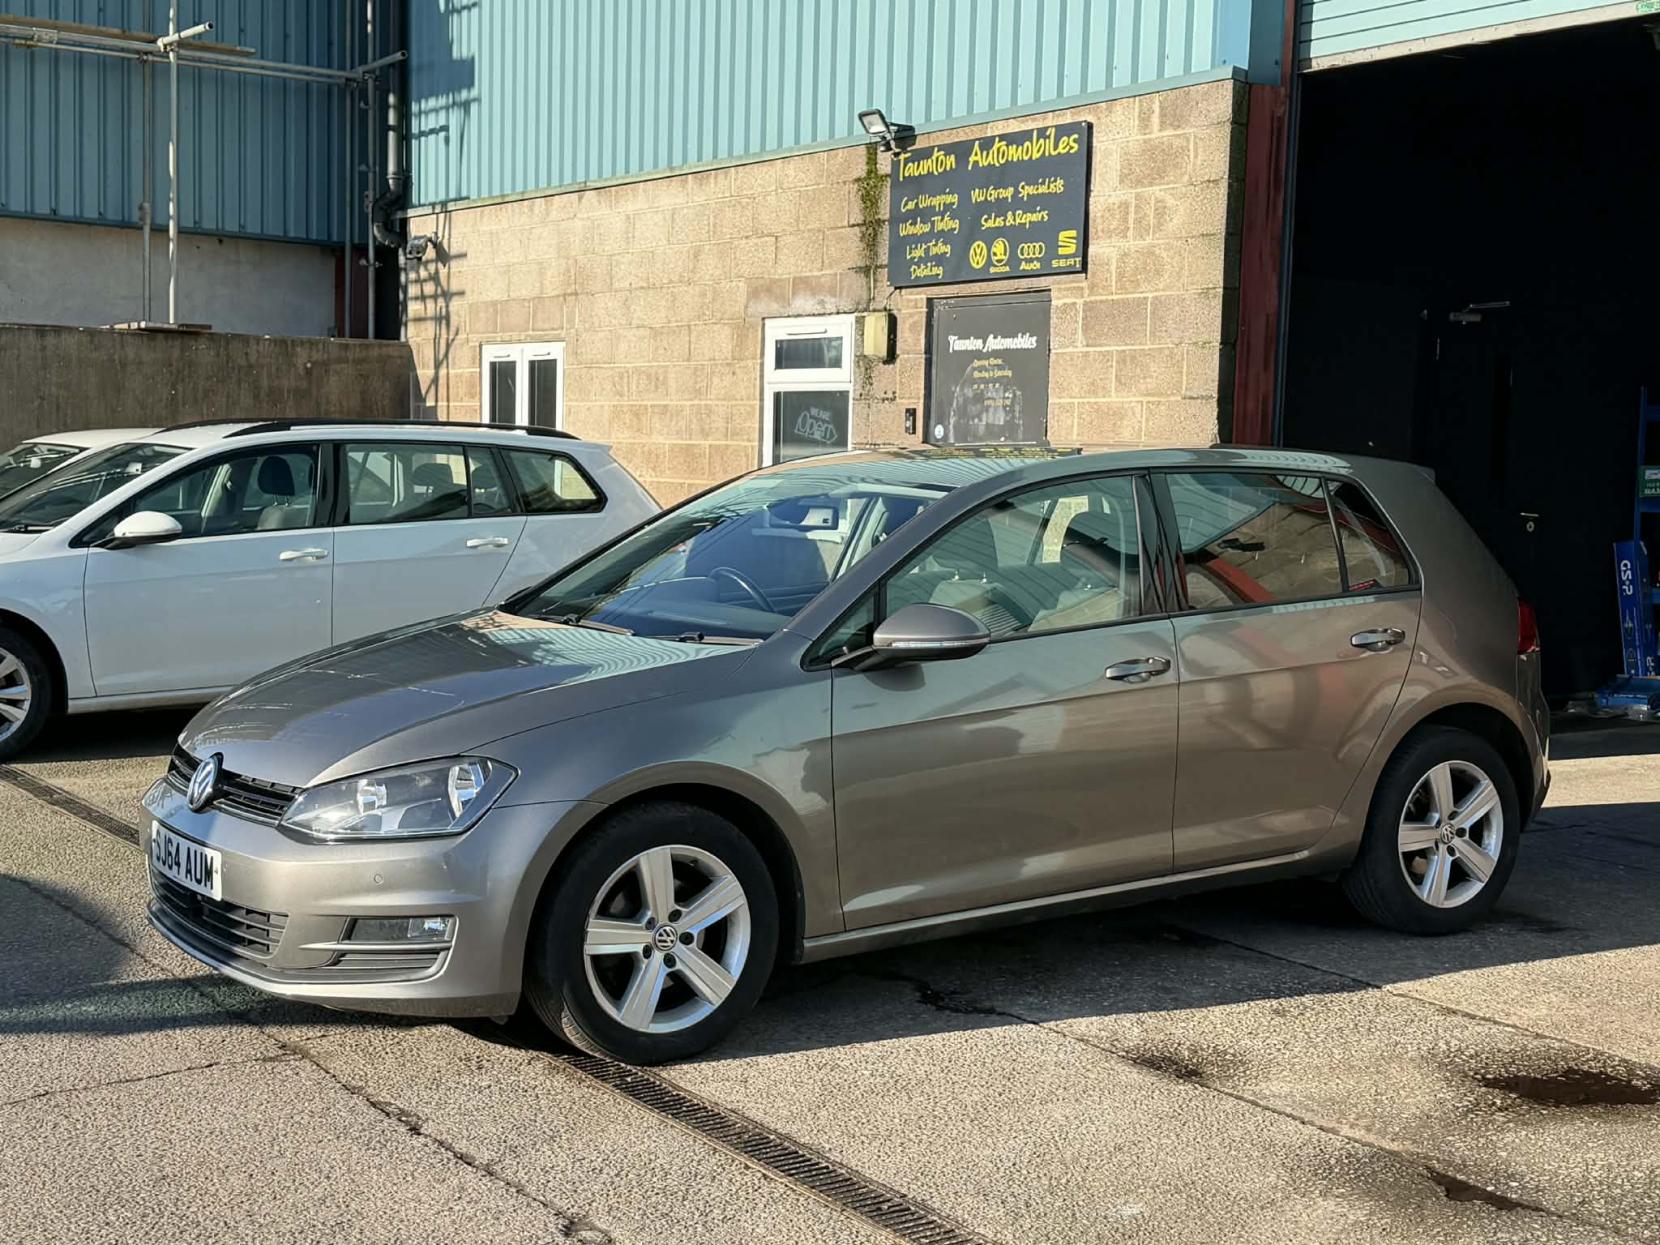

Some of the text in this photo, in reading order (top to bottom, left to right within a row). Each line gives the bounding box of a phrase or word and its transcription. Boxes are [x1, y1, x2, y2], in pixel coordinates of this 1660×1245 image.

[898, 127, 1080, 182] Taunton Automobiles
[901, 188, 958, 213] Car Wrapping
[971, 176, 1065, 204] VW Group Specialists
[899, 212, 960, 237] Window Tinting
[980, 206, 1049, 230] Sales & Repairs
[906, 238, 951, 262] Light Tinting
[910, 261, 944, 280] Detailing
[1019, 260, 1042, 271] Audi
[1051, 256, 1082, 269] SEAT
[948, 333, 1037, 353] Taunton Automobiles
[155, 829, 214, 891] SJ64 AUM
